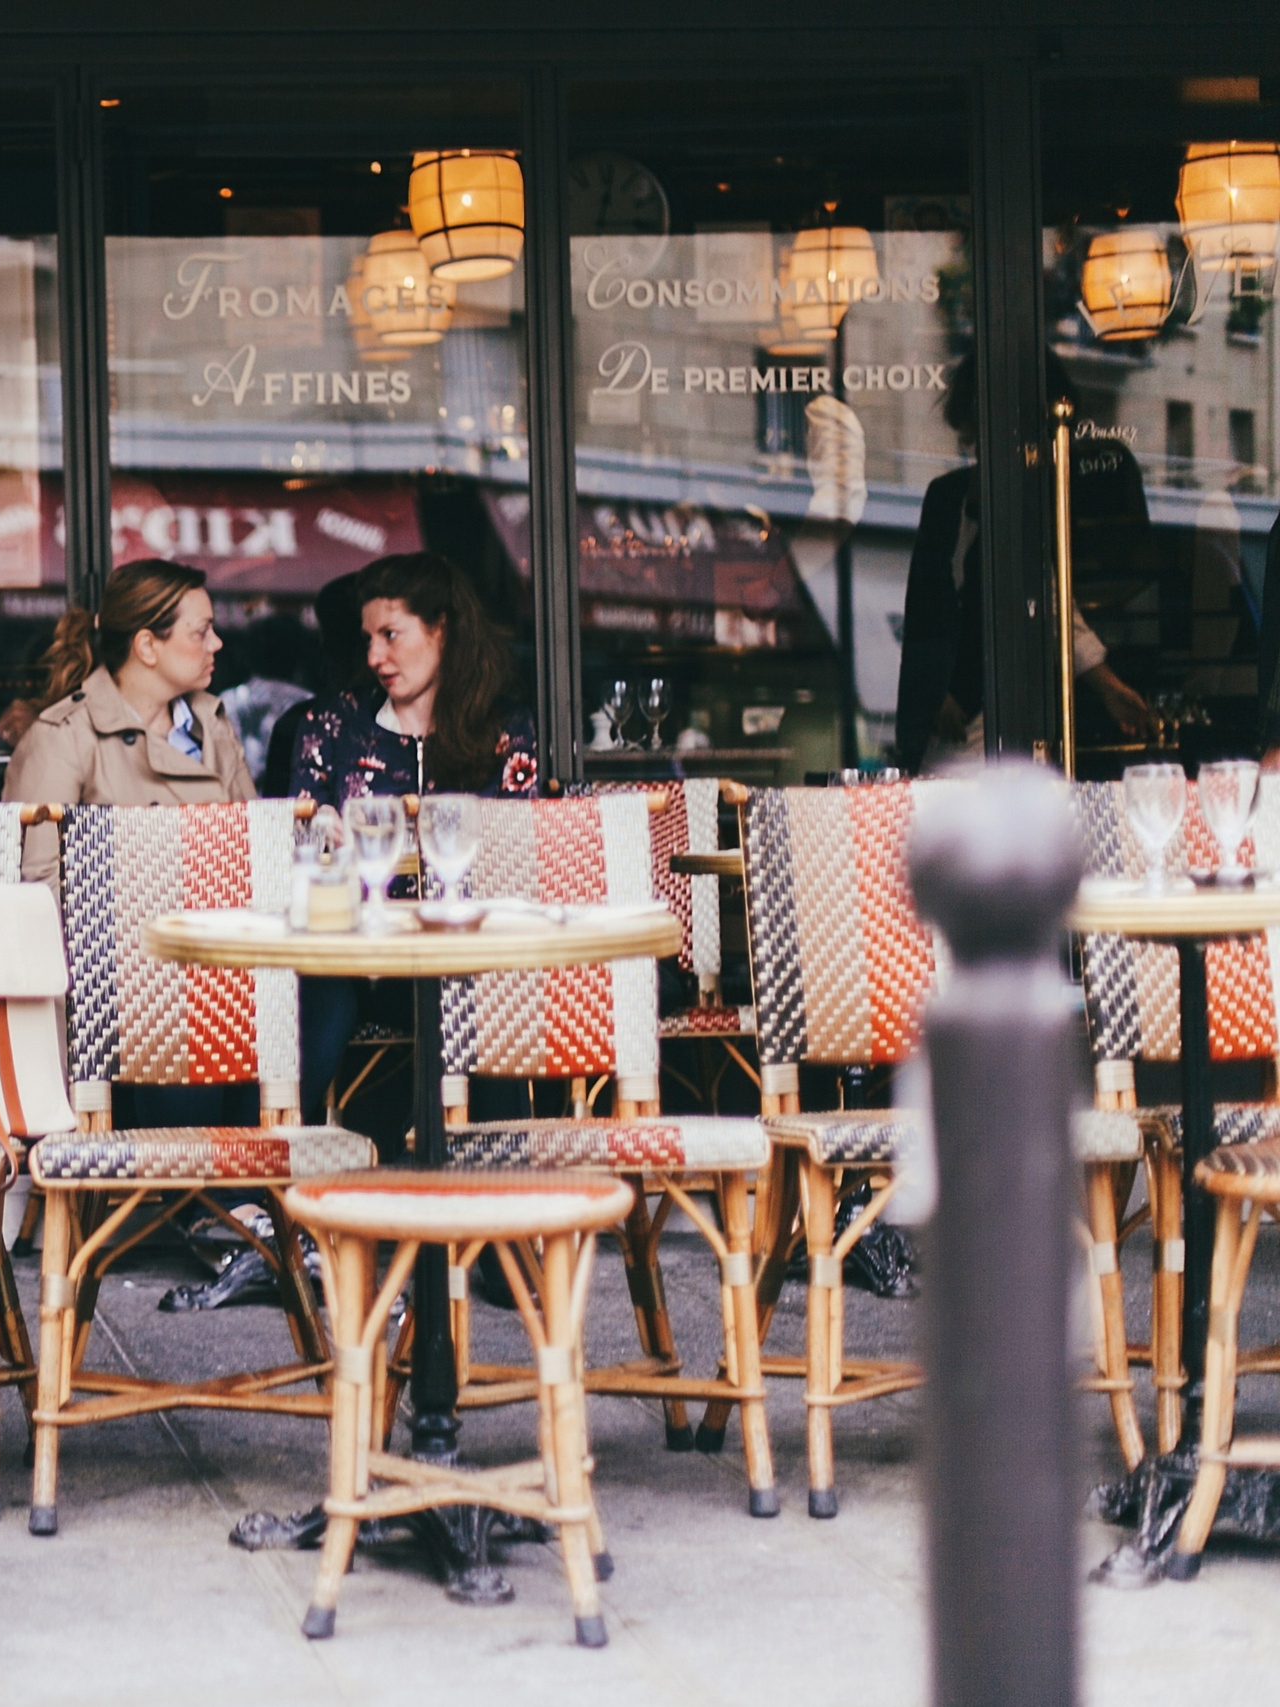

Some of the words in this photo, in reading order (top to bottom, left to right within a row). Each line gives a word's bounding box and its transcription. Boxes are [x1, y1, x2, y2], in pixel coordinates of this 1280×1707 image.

[162, 252, 449, 321] FROMAGES
[584, 243, 941, 310] CONSOMMATIONS
[192, 344, 412, 407] AFFINES
[592, 341, 669, 396] DE
[683, 366, 833, 393] PREMIER
[842, 364, 947, 391] CHOIX
